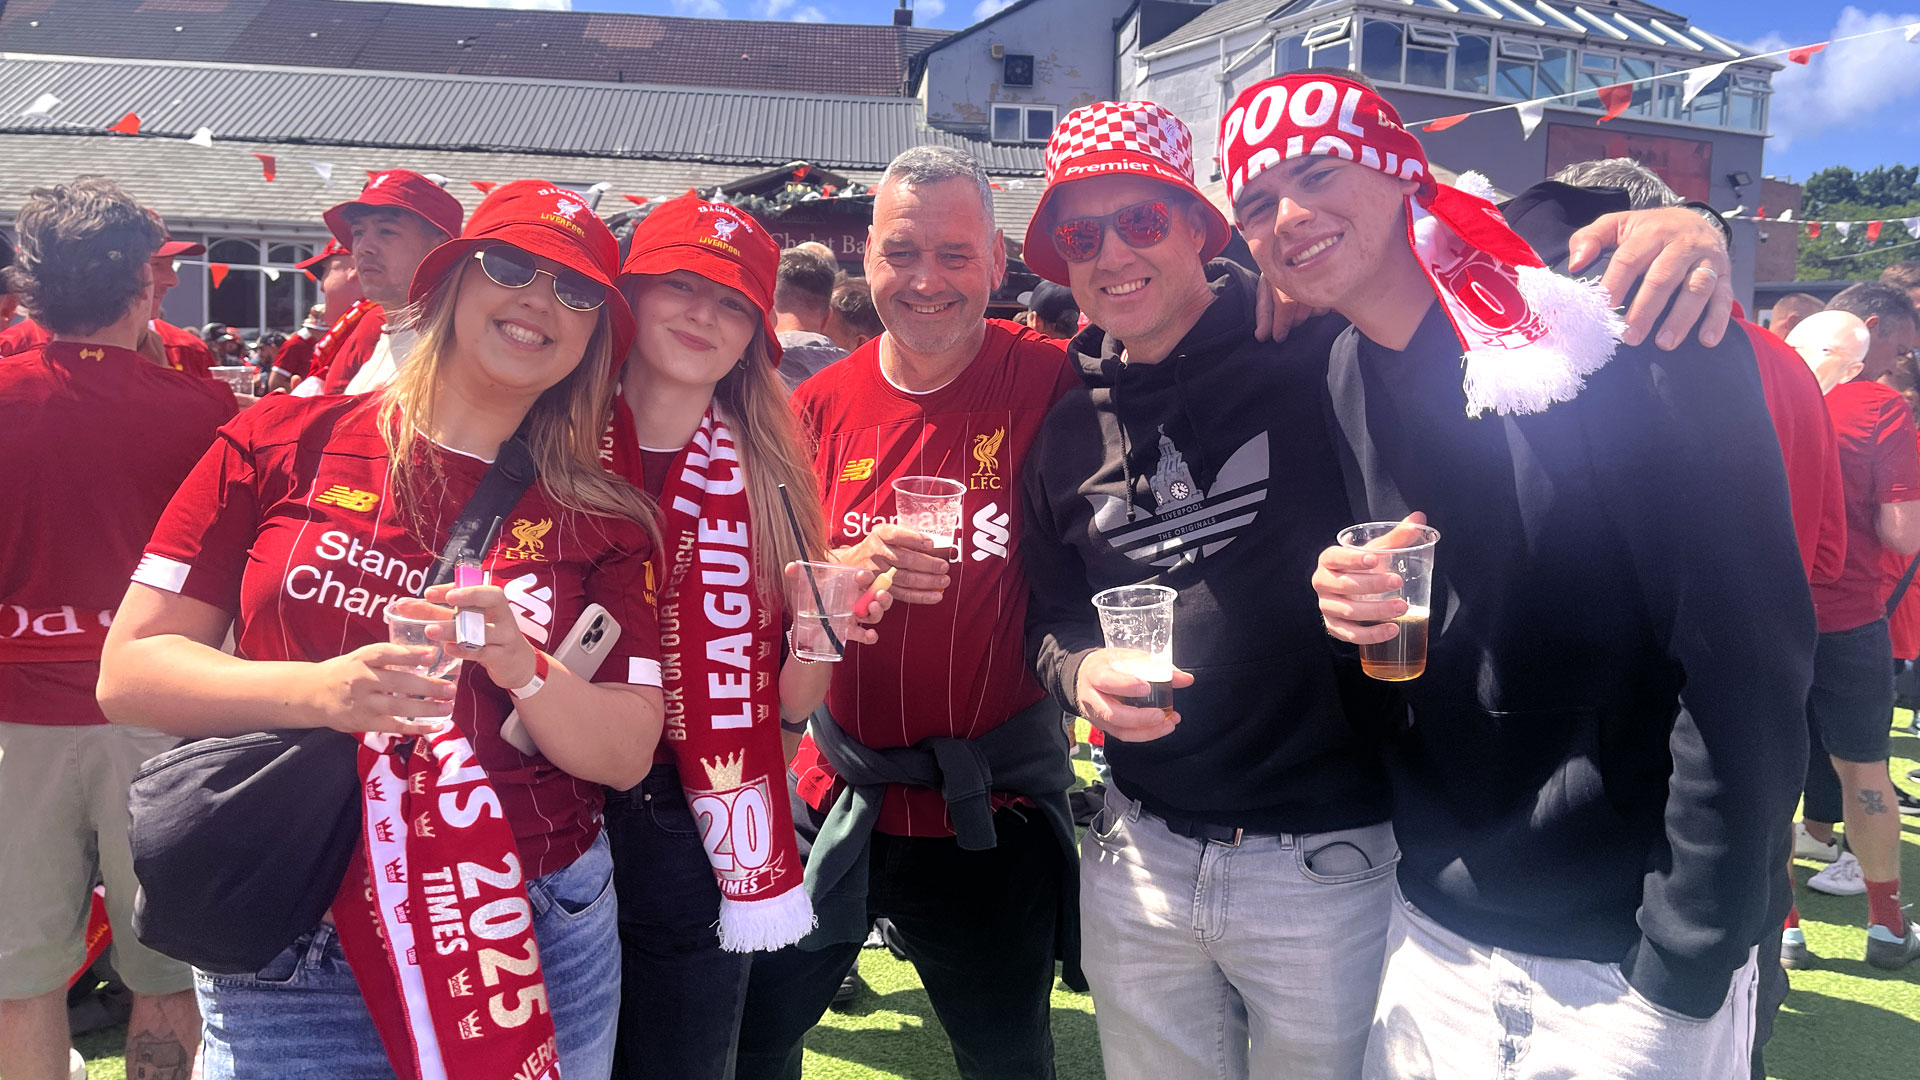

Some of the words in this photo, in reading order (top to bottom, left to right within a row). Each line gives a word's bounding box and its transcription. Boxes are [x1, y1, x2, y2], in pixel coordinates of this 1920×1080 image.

[1222, 81, 1364, 178] POOL
[1065, 159, 1150, 176] Premier
[541, 212, 585, 238] LIVERPOOL
[699, 236, 742, 257] LIVERPOOL
[1158, 532, 1172, 541] THE
[1174, 517, 1217, 537] ORIGINALS
[1161, 503, 1203, 521] LIVERPOOL
[660, 603, 680, 645] OUR
[698, 518, 753, 729] LEAGUE
[661, 656, 682, 680] ON
[667, 686, 687, 741] BACK
[424, 720, 503, 829] NS
[691, 787, 771, 871] 20
[422, 867, 470, 956] TIMES
[457, 851, 548, 1029] 2025
[512, 1036, 556, 1080] VERP
